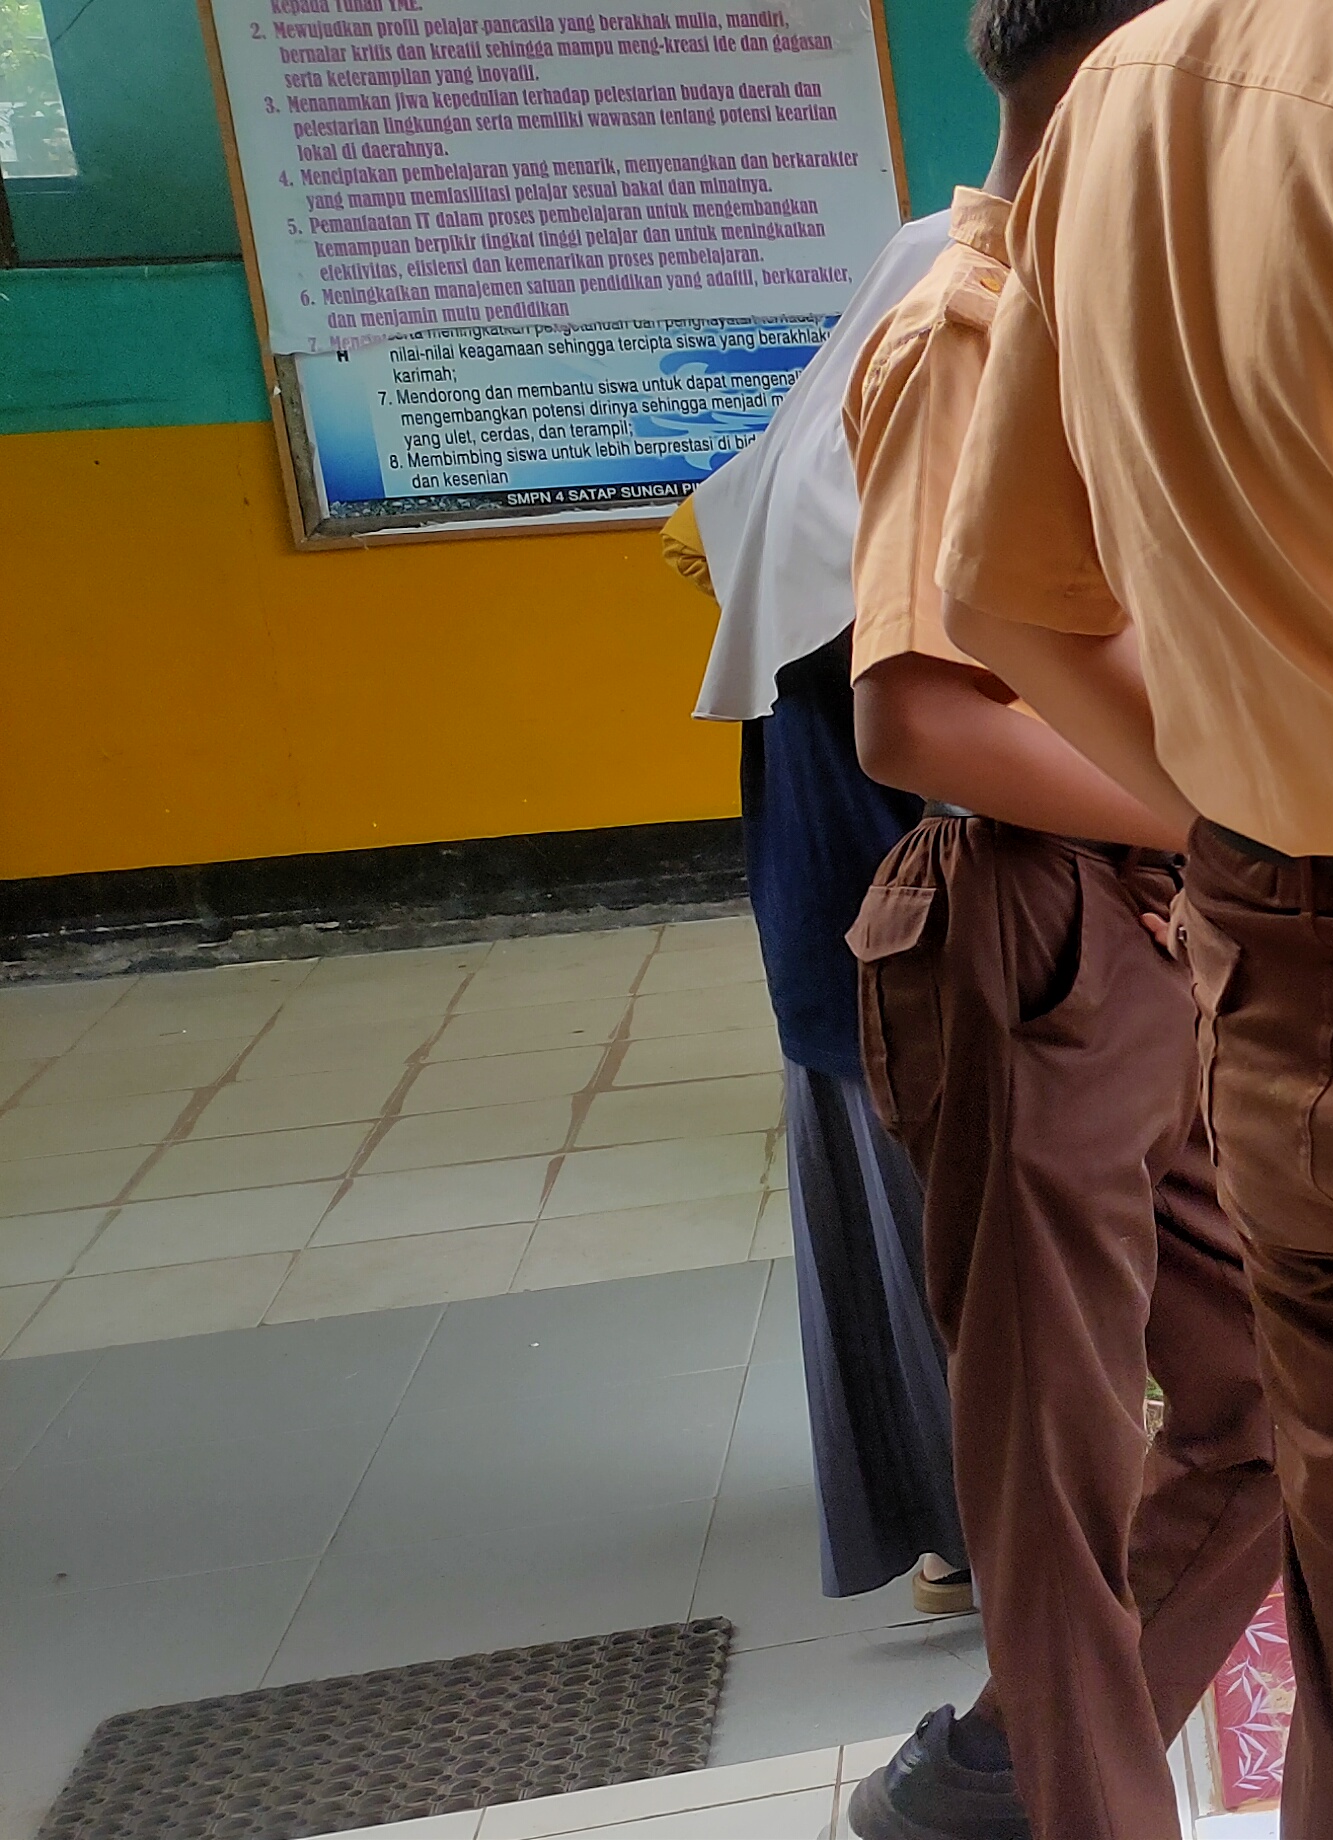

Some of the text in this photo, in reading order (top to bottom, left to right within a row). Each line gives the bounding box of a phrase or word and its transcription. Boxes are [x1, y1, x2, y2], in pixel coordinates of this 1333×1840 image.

[252, 23, 266, 40] 2.
[275, 20, 373, 41] Mewujudkan
[424, 18, 478, 38] pelajar
[481, 16, 555, 37] pancasila
[559, 18, 596, 35] yang
[726, 11, 790, 29] mandiri,
[281, 45, 346, 63] bernalar
[396, 44, 427, 61] dan
[486, 41, 554, 60] sehingga
[557, 41, 614, 58] mampu
[713, 36, 737, 53] ide
[740, 35, 769, 52] dan
[772, 36, 833, 54] gagasan
[285, 70, 323, 88] serta
[327, 68, 432, 88] keterampilan
[436, 69, 474, 87] yang
[266, 81, 822, 114] 3. Menanamkan jiwa kepedulian terhadap pelestarian budaya daerah dan
[294, 117, 380, 138] pelestarian
[383, 115, 473, 135] lingkungan
[476, 113, 513, 131] serta
[517, 111, 584, 130] memiliki
[589, 112, 657, 128] wawasan
[660, 108, 716, 127] tentang
[720, 106, 772, 127] potensi
[298, 140, 449, 161] lokal di daerahnya.
[279, 150, 858, 186] 4. Menciptakan pembelajaran yang menarik, menyenangkan dan berkarakter
[308, 195, 344, 213] yang
[348, 192, 407, 209] mampu
[512, 184, 568, 204] pelajar
[573, 181, 618, 199] sesuai
[622, 179, 664, 197] bakat
[668, 178, 697, 195] dan
[700, 176, 773, 195] minatnya.
[288, 217, 303, 234] 5.
[310, 213, 413, 233] Pemanfaatan
[435, 211, 484, 229] dalam
[488, 211, 536, 229] proses
[539, 205, 643, 227] pembelajaran
[646, 202, 690, 221] untuk
[693, 198, 819, 220] mengembangkan
[316, 221, 826, 258] kemampuan berpikir tingkat tinggi pelajar dan untuk meningkatkan
[471, 257, 502, 274] dan
[505, 253, 605, 273] kemenarikan
[608, 253, 655, 271] proses
[658, 247, 764, 269] pembelajaran.
[300, 289, 315, 306] 6.
[323, 285, 431, 306] Meningkatkan
[434, 282, 524, 301] manajemen
[525, 279, 576, 297] satuan
[580, 275, 663, 297] pendidikan
[667, 275, 703, 293] yang
[762, 267, 853, 287] berkarakter,
[327, 300, 570, 329] dan menjamin mutu pendidikan
[390, 344, 456, 362] nilai-nilai
[459, 343, 544, 362] keagamaan
[547, 338, 617, 357] sehingga
[617, 335, 673, 355] tercipta
[675, 334, 718, 350] siswa
[720, 334, 756, 352] yang
[377, 389, 394, 405] 7.
[395, 387, 483, 405] Mendorong
[484, 384, 514, 400] dan
[516, 380, 595, 398] membantu
[597, 378, 640, 394] siswa
[641, 375, 684, 392] untuk
[686, 373, 728, 393] dapat
[393, 365, 458, 384] karimah;
[400, 405, 529, 428] mengembangkan
[531, 401, 587, 423] potensi
[589, 399, 640, 418] dirinya
[641, 396, 708, 415] sehingga
[711, 392, 769, 413] menjadi
[388, 453, 405, 469] 8.
[407, 448, 504, 468] Membimbing
[506, 446, 549, 462] siswa
[550, 441, 593, 460] untuk
[595, 439, 631, 457] lebih
[633, 434, 716, 457] berprestasi
[717, 433, 732, 450] di
[403, 419, 635, 451] yang ulet, cerdas, dan terampil;
[411, 469, 510, 489] dan kesenian
[507, 491, 552, 505] SMPN
[555, 490, 565, 502] 4
[568, 487, 617, 502] SATAP
[620, 484, 679, 499] SUNGAI
